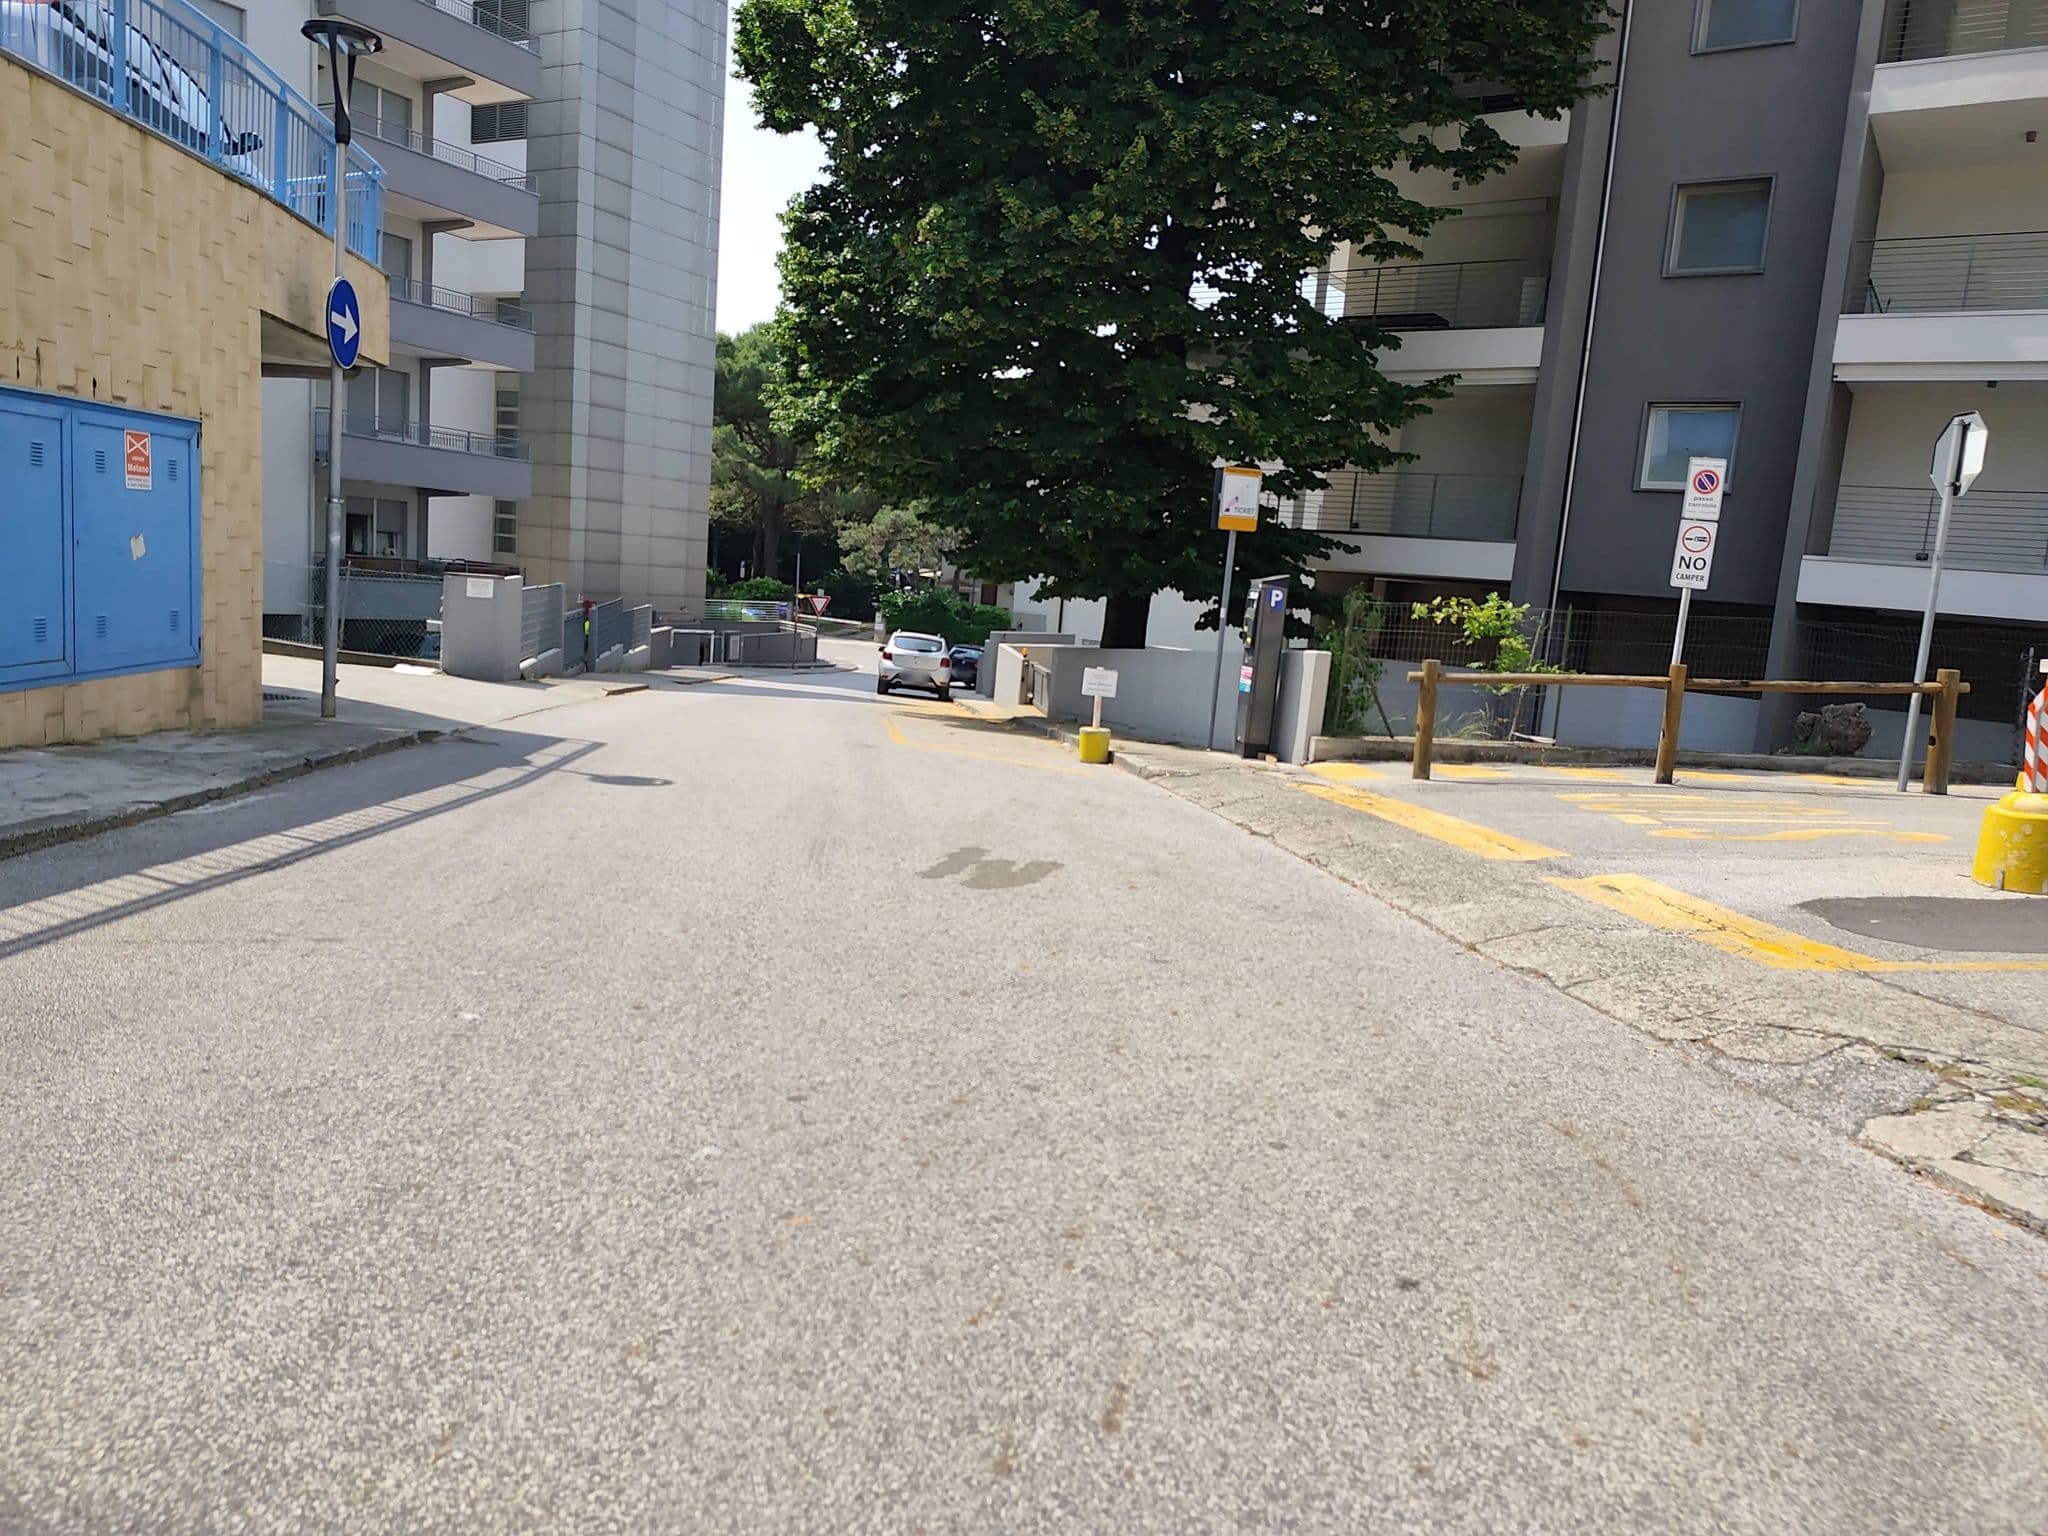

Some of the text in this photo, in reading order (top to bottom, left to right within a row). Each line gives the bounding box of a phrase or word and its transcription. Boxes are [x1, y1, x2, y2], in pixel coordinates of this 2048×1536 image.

[128, 463, 149, 473] Metano
[1234, 506, 1255, 515] TICKET
[1678, 555, 1707, 571] NO
[1675, 572, 1705, 582] CAMPER
[1270, 589, 1284, 608] P
